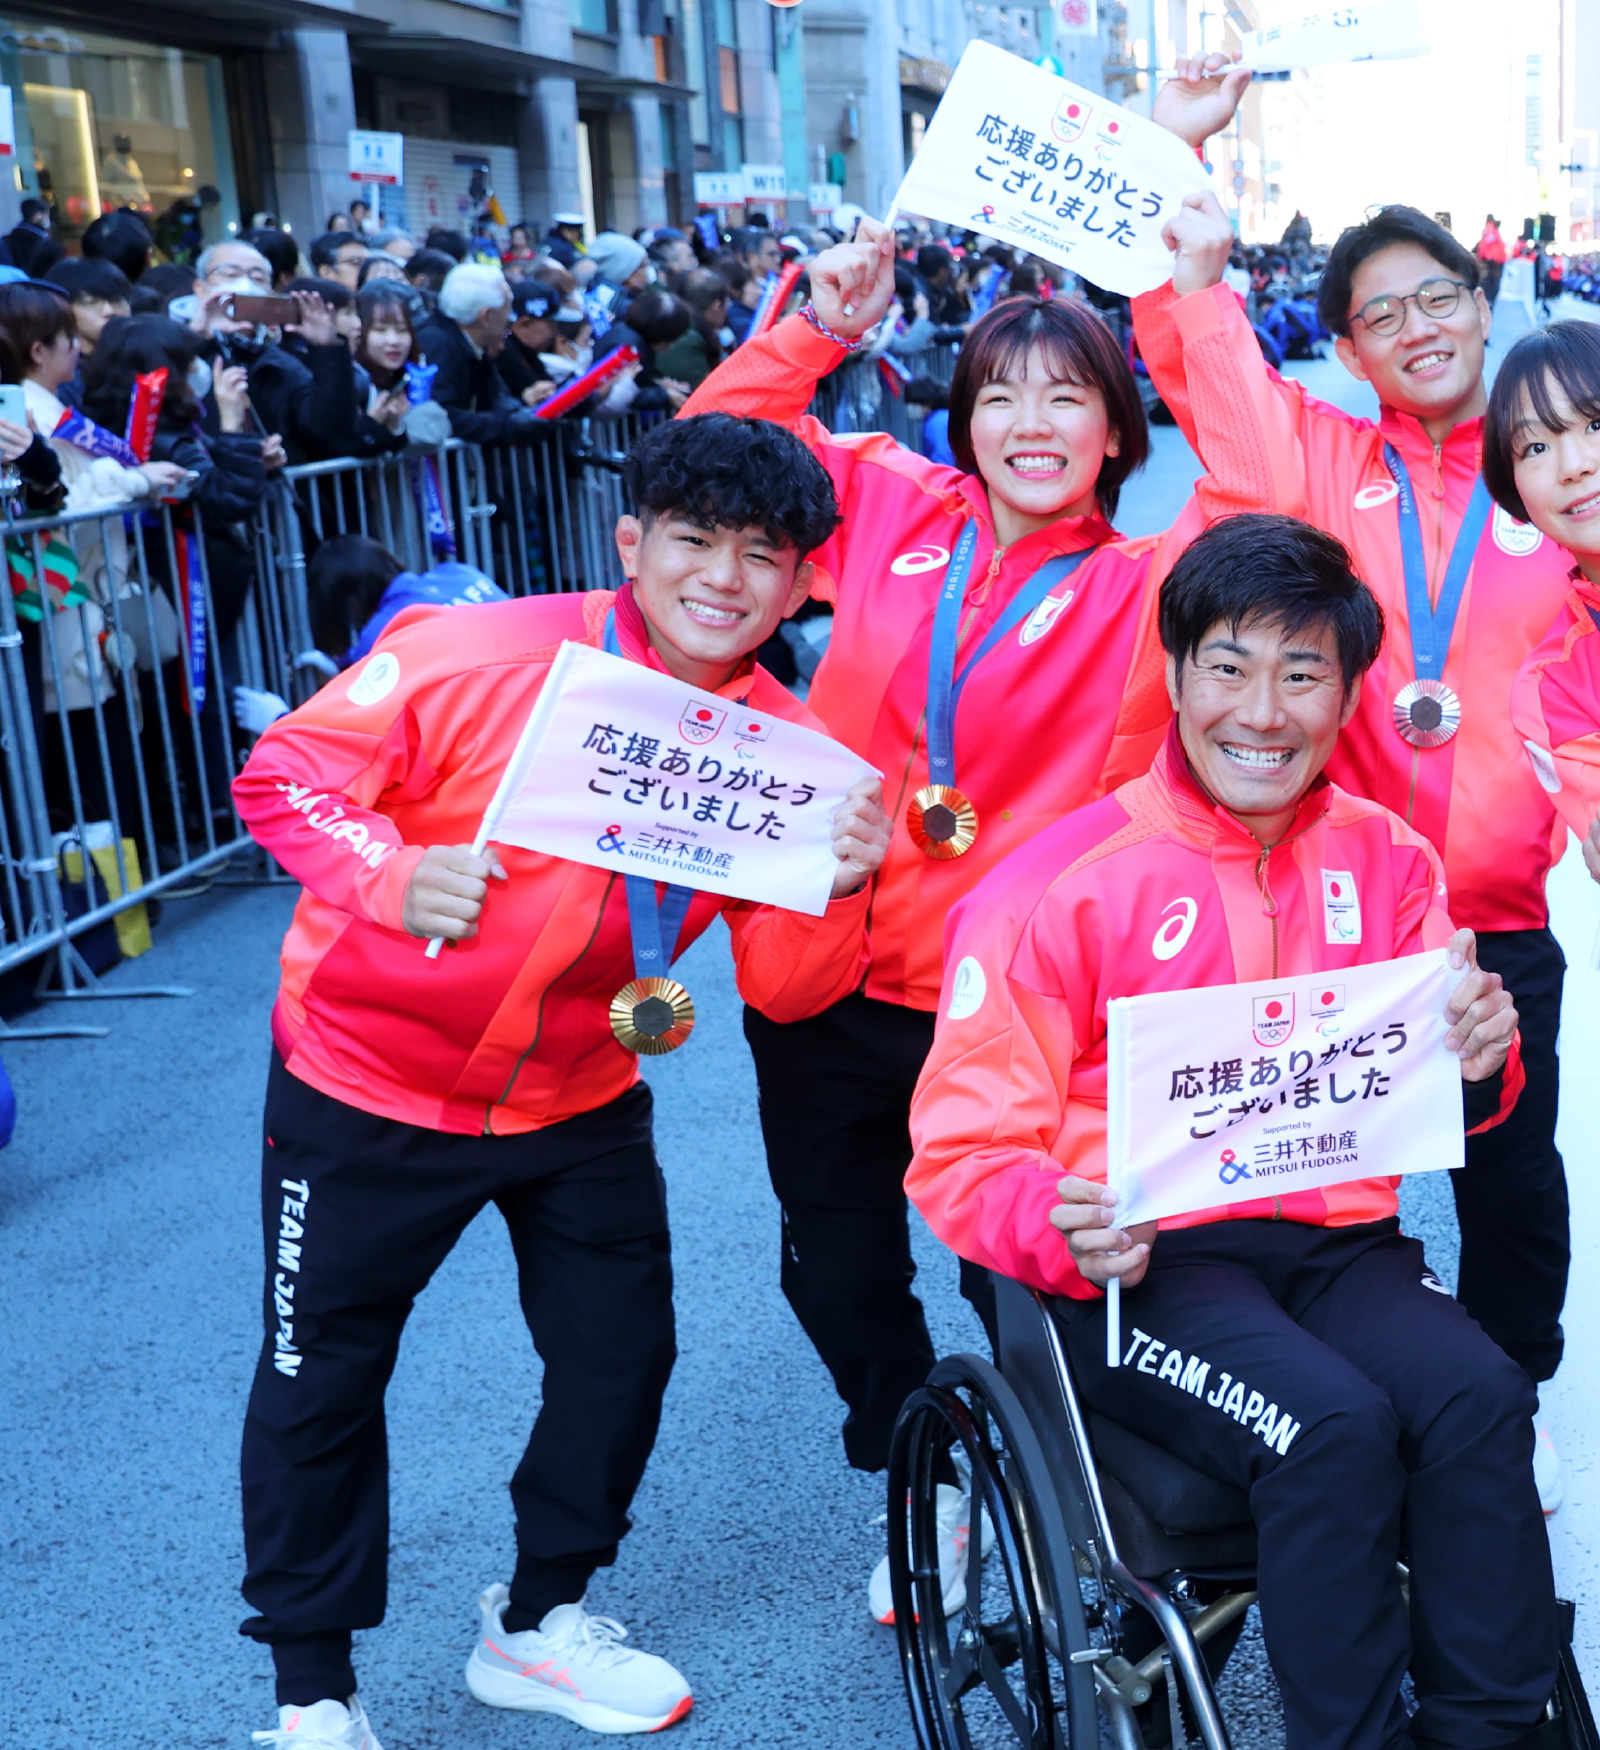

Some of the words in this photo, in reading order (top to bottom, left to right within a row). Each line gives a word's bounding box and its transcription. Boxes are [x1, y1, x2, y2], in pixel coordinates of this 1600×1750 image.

[976, 113, 1163, 218] 応援ありがとう
[975, 155, 1137, 248] ございました
[944, 565, 963, 599] PARIS
[956, 531, 974, 562] 2024
[684, 718, 700, 727] TEAM
[699, 723, 715, 732] JAPAN
[582, 723, 817, 806] 応援ありがとう
[588, 766, 787, 841] ございました
[654, 821, 688, 837] Supported
[688, 829, 699, 839] by
[628, 848, 672, 867] MITSUI
[671, 859, 730, 881] FUDOSAN
[631, 831, 736, 871] 三井不動産
[1257, 1021, 1273, 1029] TEAM
[1272, 1019, 1290, 1028] JAPAN
[1168, 1022, 1408, 1101] 応援ありがとう
[1253, 1130, 1359, 1164] 三井不動産
[1262, 1123, 1301, 1136] Supported
[1301, 1119, 1313, 1131] by
[1255, 1162, 1299, 1178] MITSUI
[1301, 1151, 1359, 1171] FUDOSAN
[280, 1178, 310, 1273] TEAM
[274, 1272, 303, 1378] JAPAN
[1122, 1327, 1212, 1399] TEAM
[1206, 1371, 1302, 1457] JAPAN
